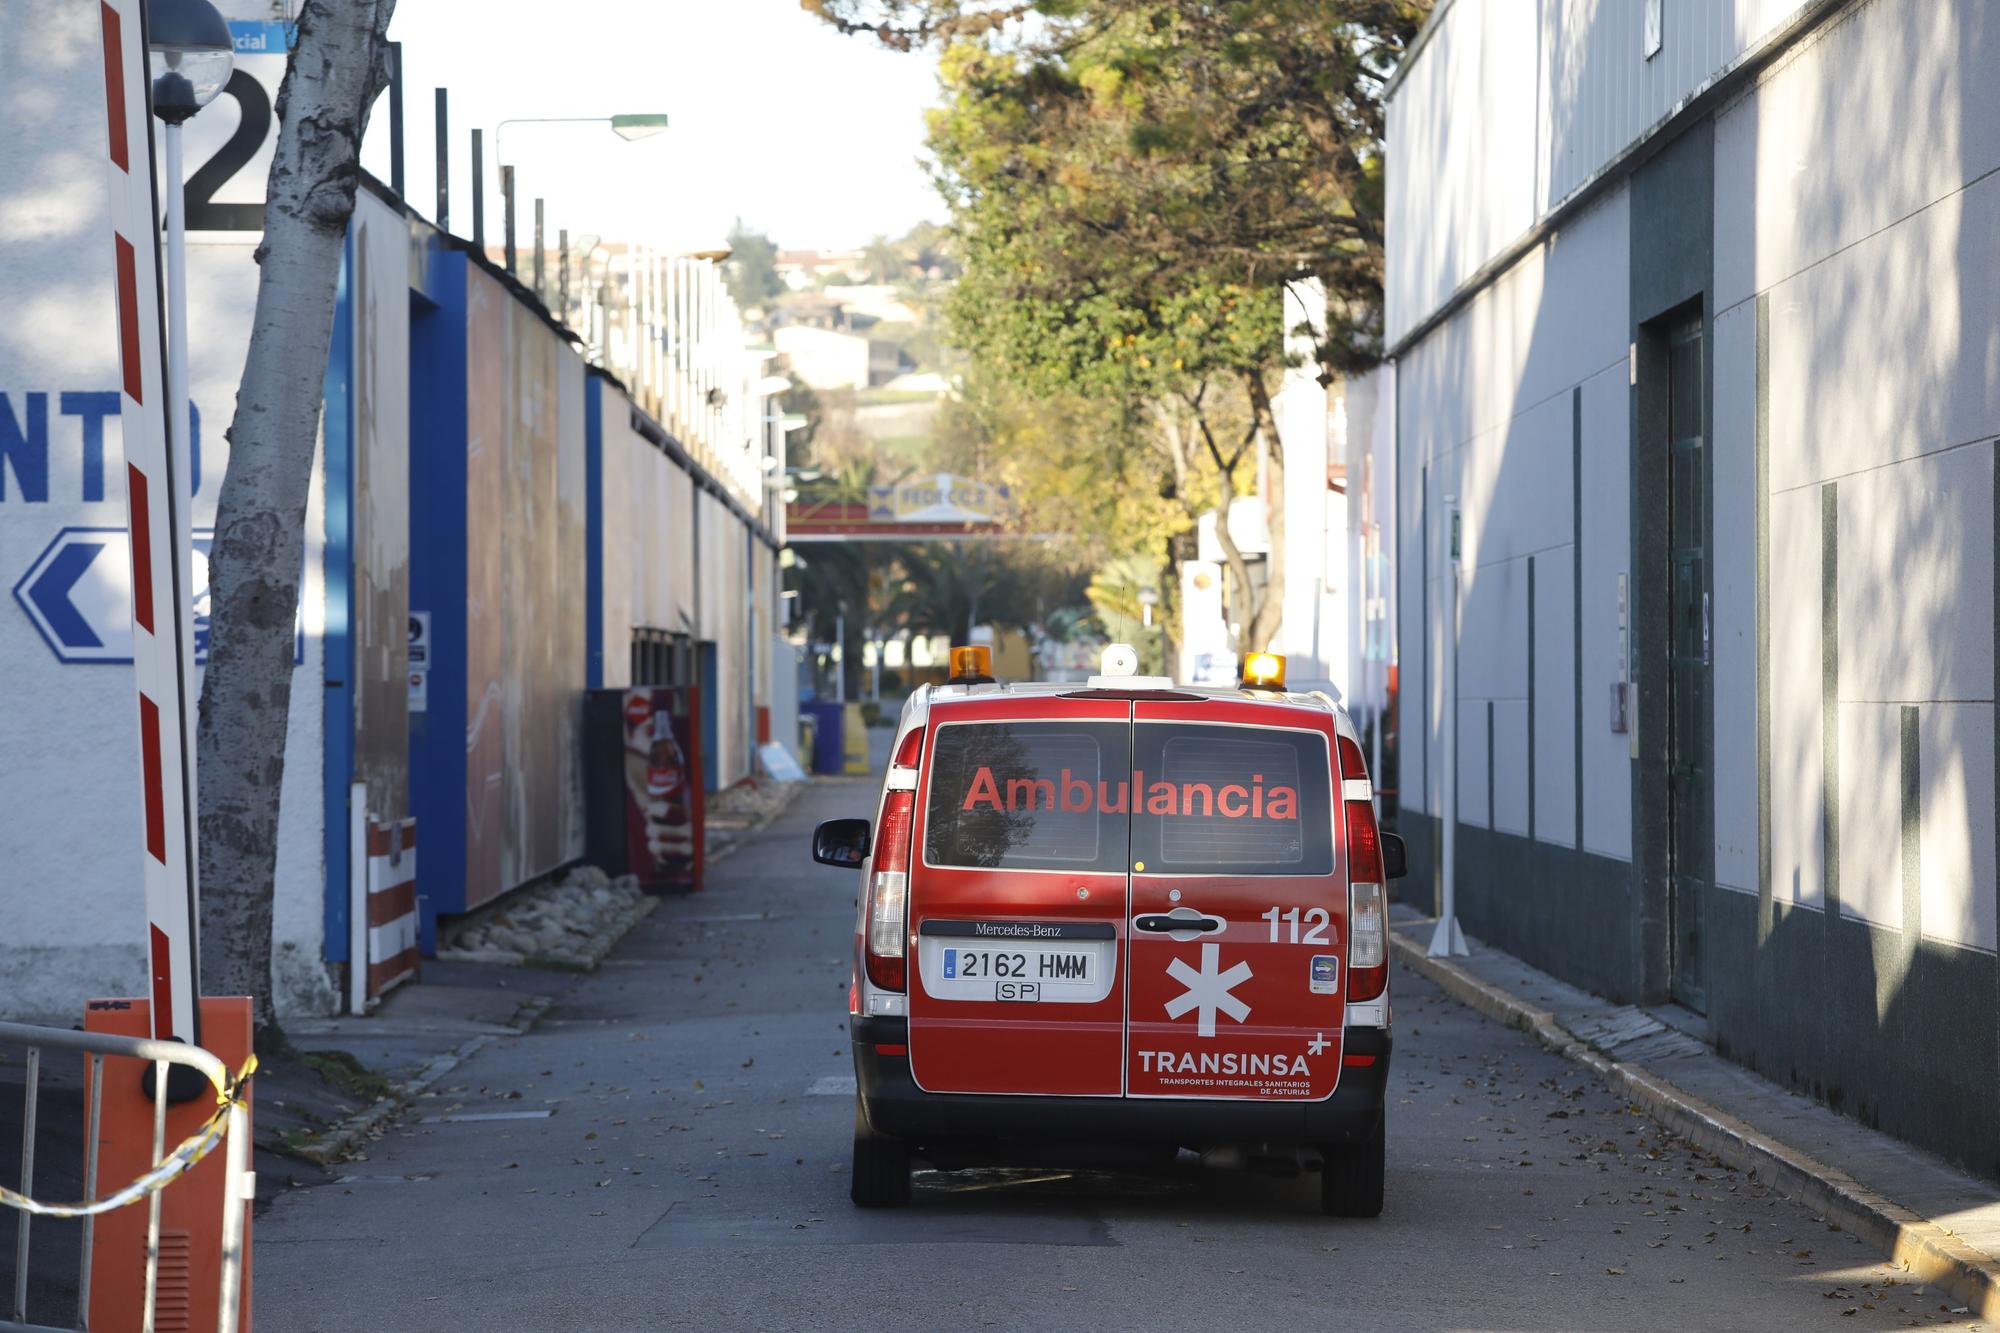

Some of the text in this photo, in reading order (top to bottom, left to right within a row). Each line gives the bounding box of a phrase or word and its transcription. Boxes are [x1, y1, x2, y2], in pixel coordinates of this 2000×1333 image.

[0, 391, 201, 503] NT
[962, 767, 1298, 820] Ambulancia
[975, 923, 1062, 937] Mercedes-Benz
[1261, 906, 1330, 945] 112
[962, 953, 1026, 977] 2162
[1039, 954, 1087, 979] HMM
[1138, 1050, 1311, 1076] TRANSINSA
[1159, 1078, 1310, 1088] TRANSPORTES INTEGRALES SANITARIOS
[1272, 1088, 1310, 1096] ASTURIAS
